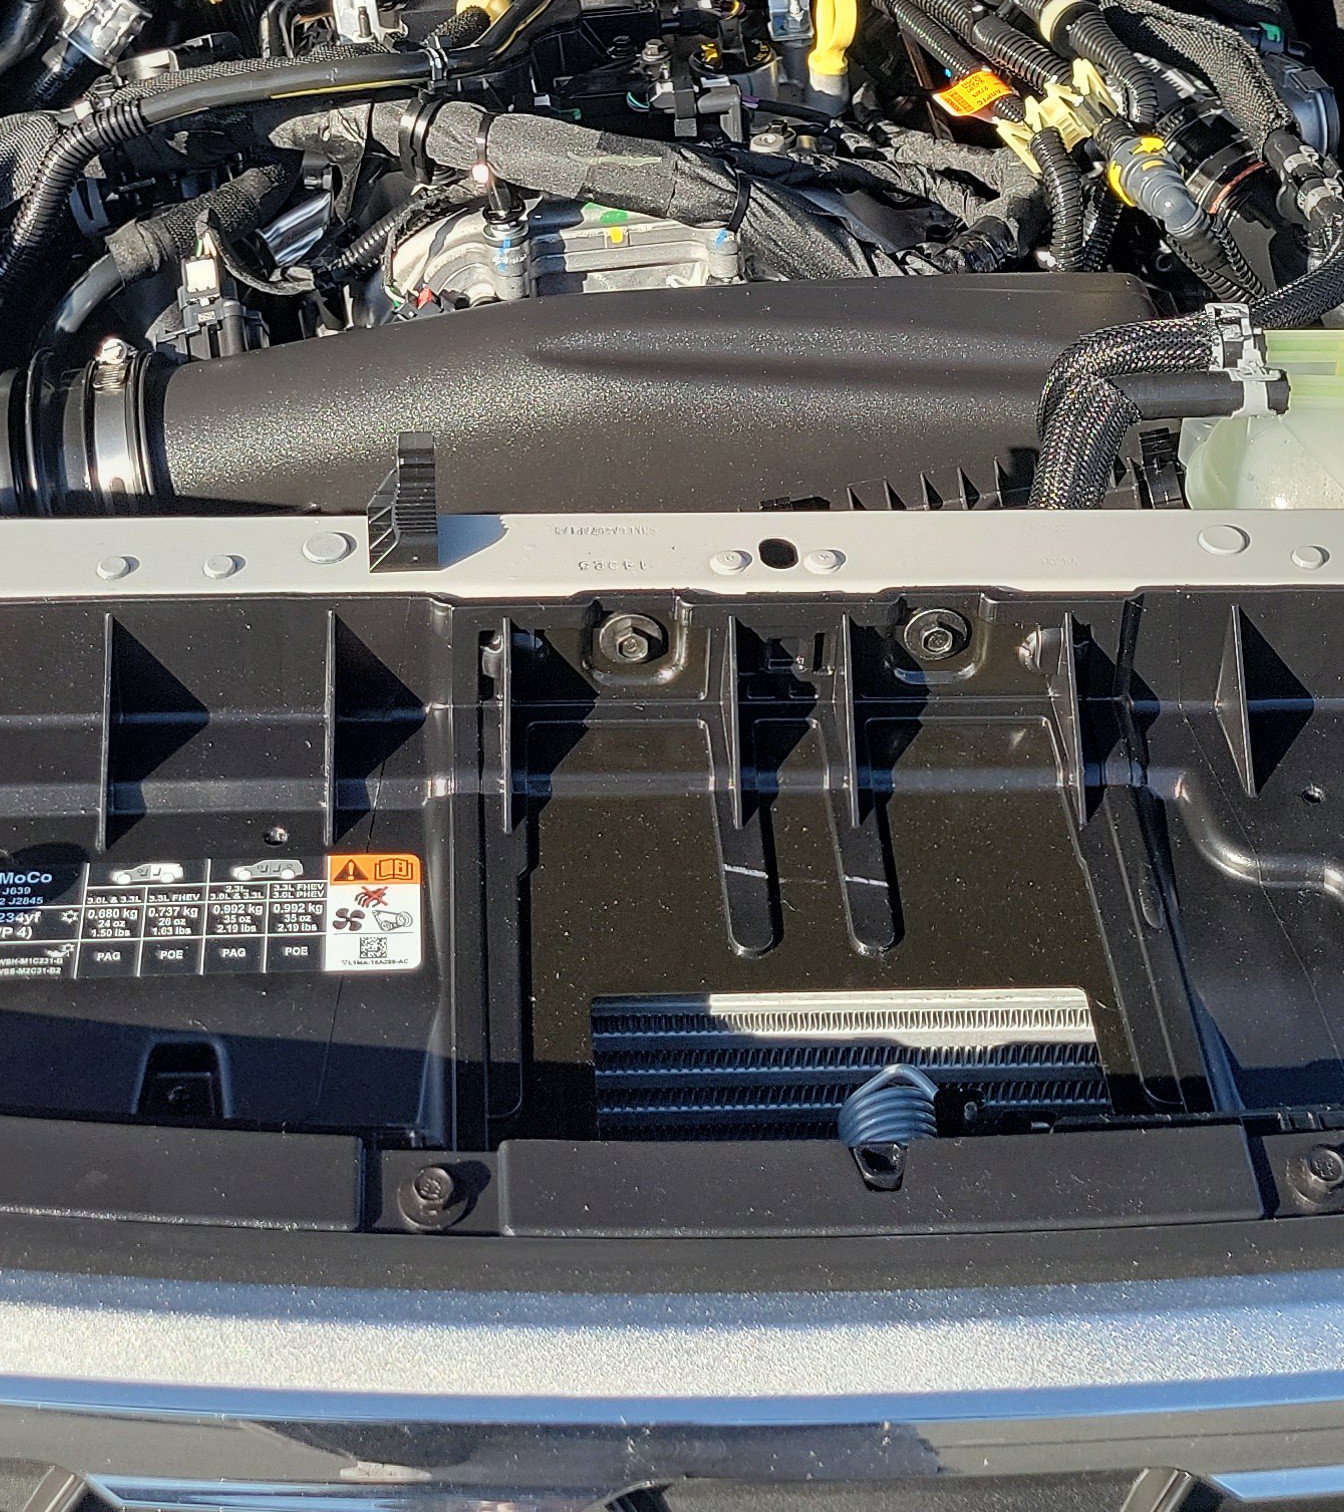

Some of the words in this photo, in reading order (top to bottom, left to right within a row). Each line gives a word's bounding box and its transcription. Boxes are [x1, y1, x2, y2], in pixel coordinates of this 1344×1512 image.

[2, 886, 32, 896] J639
[273, 884, 295, 892] 3.3L
[296, 883, 325, 891] FHEV
[87, 896, 109, 904] 3.0L
[110, 896, 118, 904] &
[120, 895, 142, 904] 3.3L
[148, 894, 170, 903] 3.3L
[172, 893, 201, 902] FHEV
[209, 892, 232, 900] 3.0L
[233, 892, 242, 900] &
[243, 891, 265, 899] 3.3L
[272, 891, 294, 899] 3.0L
[296, 890, 325, 898] PHEV
[8, 896, 44, 906] J2845
[148, 906, 181, 917] 0.737
[182, 906, 199, 918] kg
[213, 903, 246, 915] 0.992
[248, 903, 264, 916] kg
[273, 902, 306, 914] 0.992
[308, 902, 324, 915] kg
[87, 908, 120, 919] 0.680
[122, 908, 139, 920] kg
[284, 914, 297, 923] 35
[299, 915, 312, 923] oz
[97, 919, 111, 928] 24
[112, 920, 126, 928] oz
[173, 918, 187, 926] oz
[223, 915, 237, 924] 35
[239, 916, 252, 924] oz
[175, 926, 192, 935] lbs
[216, 924, 239, 933] 2.19
[241, 923, 257, 933] lbs
[277, 923, 300, 932] 2.19
[301, 922, 318, 932] lbs
[16, 926, 34, 940] 4)
[91, 928, 113, 937] 1.50
[114, 928, 131, 937] lbs
[159, 950, 184, 960] POE
[221, 948, 247, 958] PAG
[284, 946, 309, 956] POE
[96, 951, 121, 962] PAG
